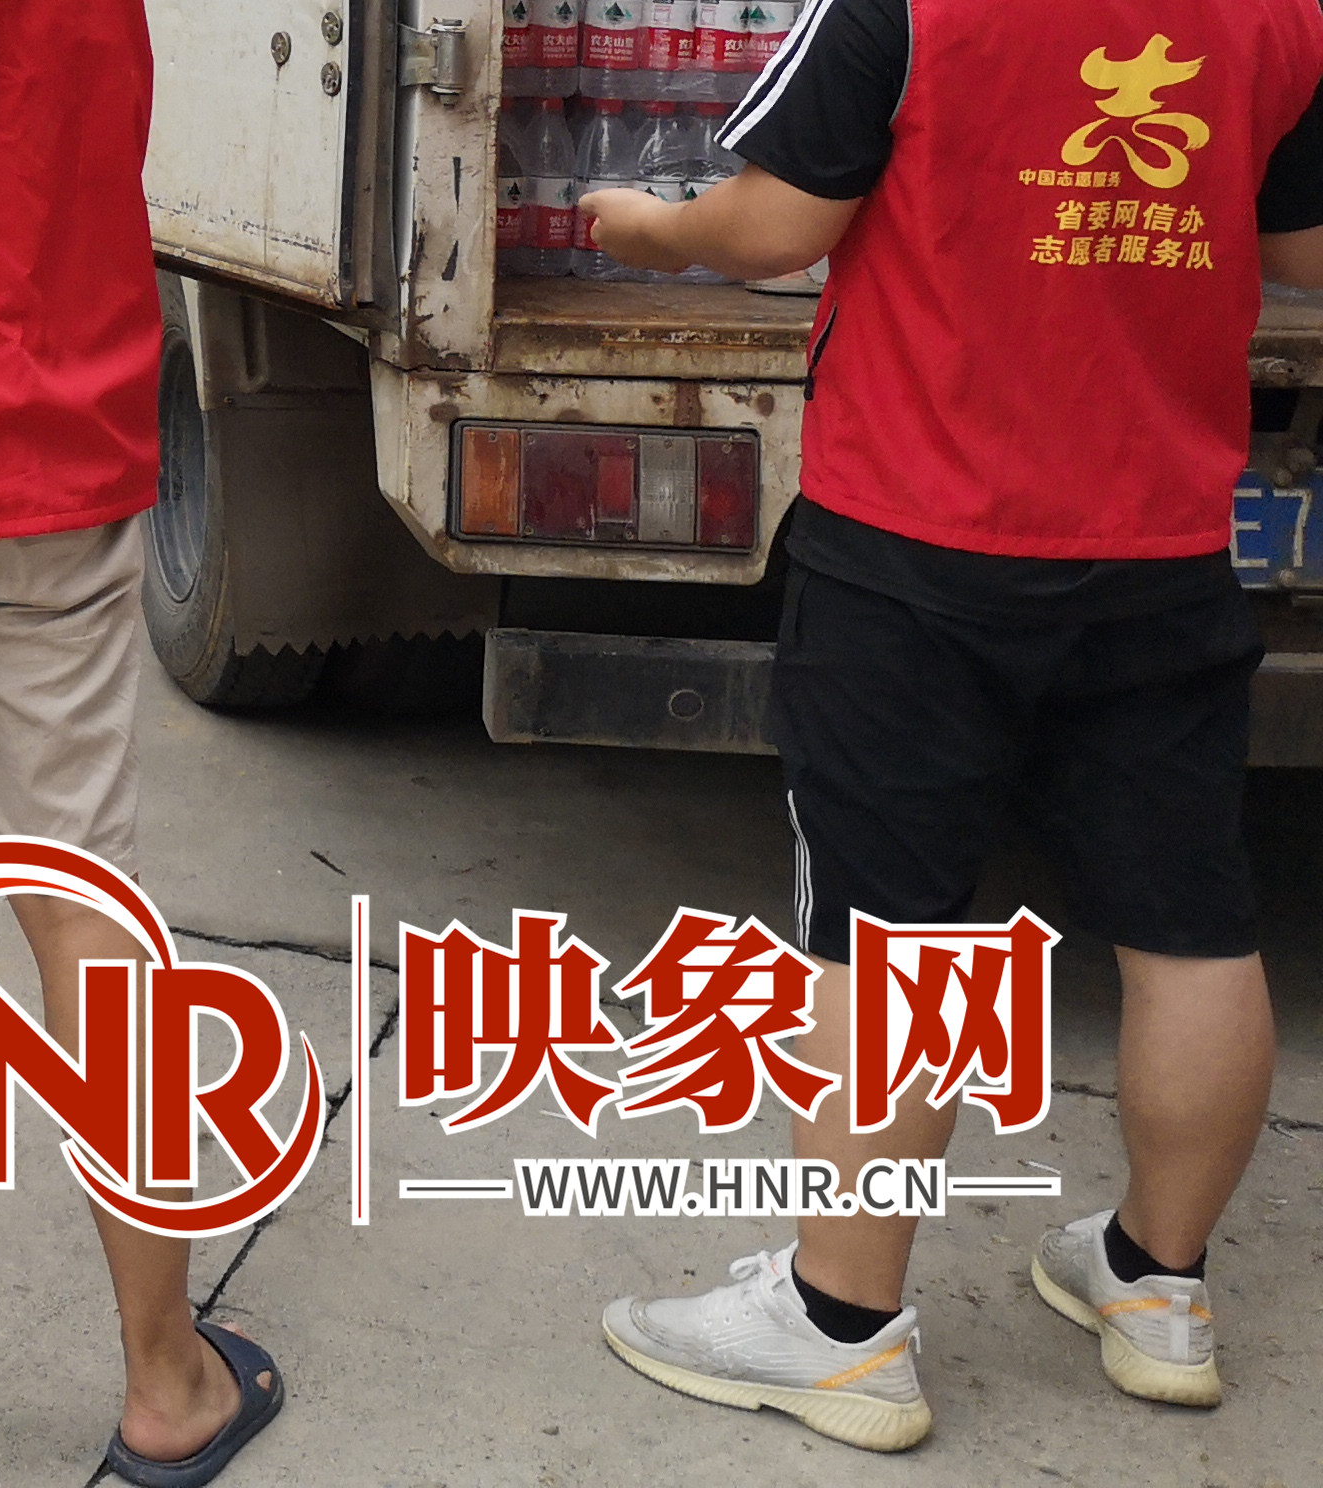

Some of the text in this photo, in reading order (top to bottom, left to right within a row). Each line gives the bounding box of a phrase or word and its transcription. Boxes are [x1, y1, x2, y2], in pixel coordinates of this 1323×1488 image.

[1018, 167, 1122, 189] 中国志愿服务
[1054, 199, 1205, 235] 省委网信办
[1029, 234, 1214, 271] 志愿者服务队
